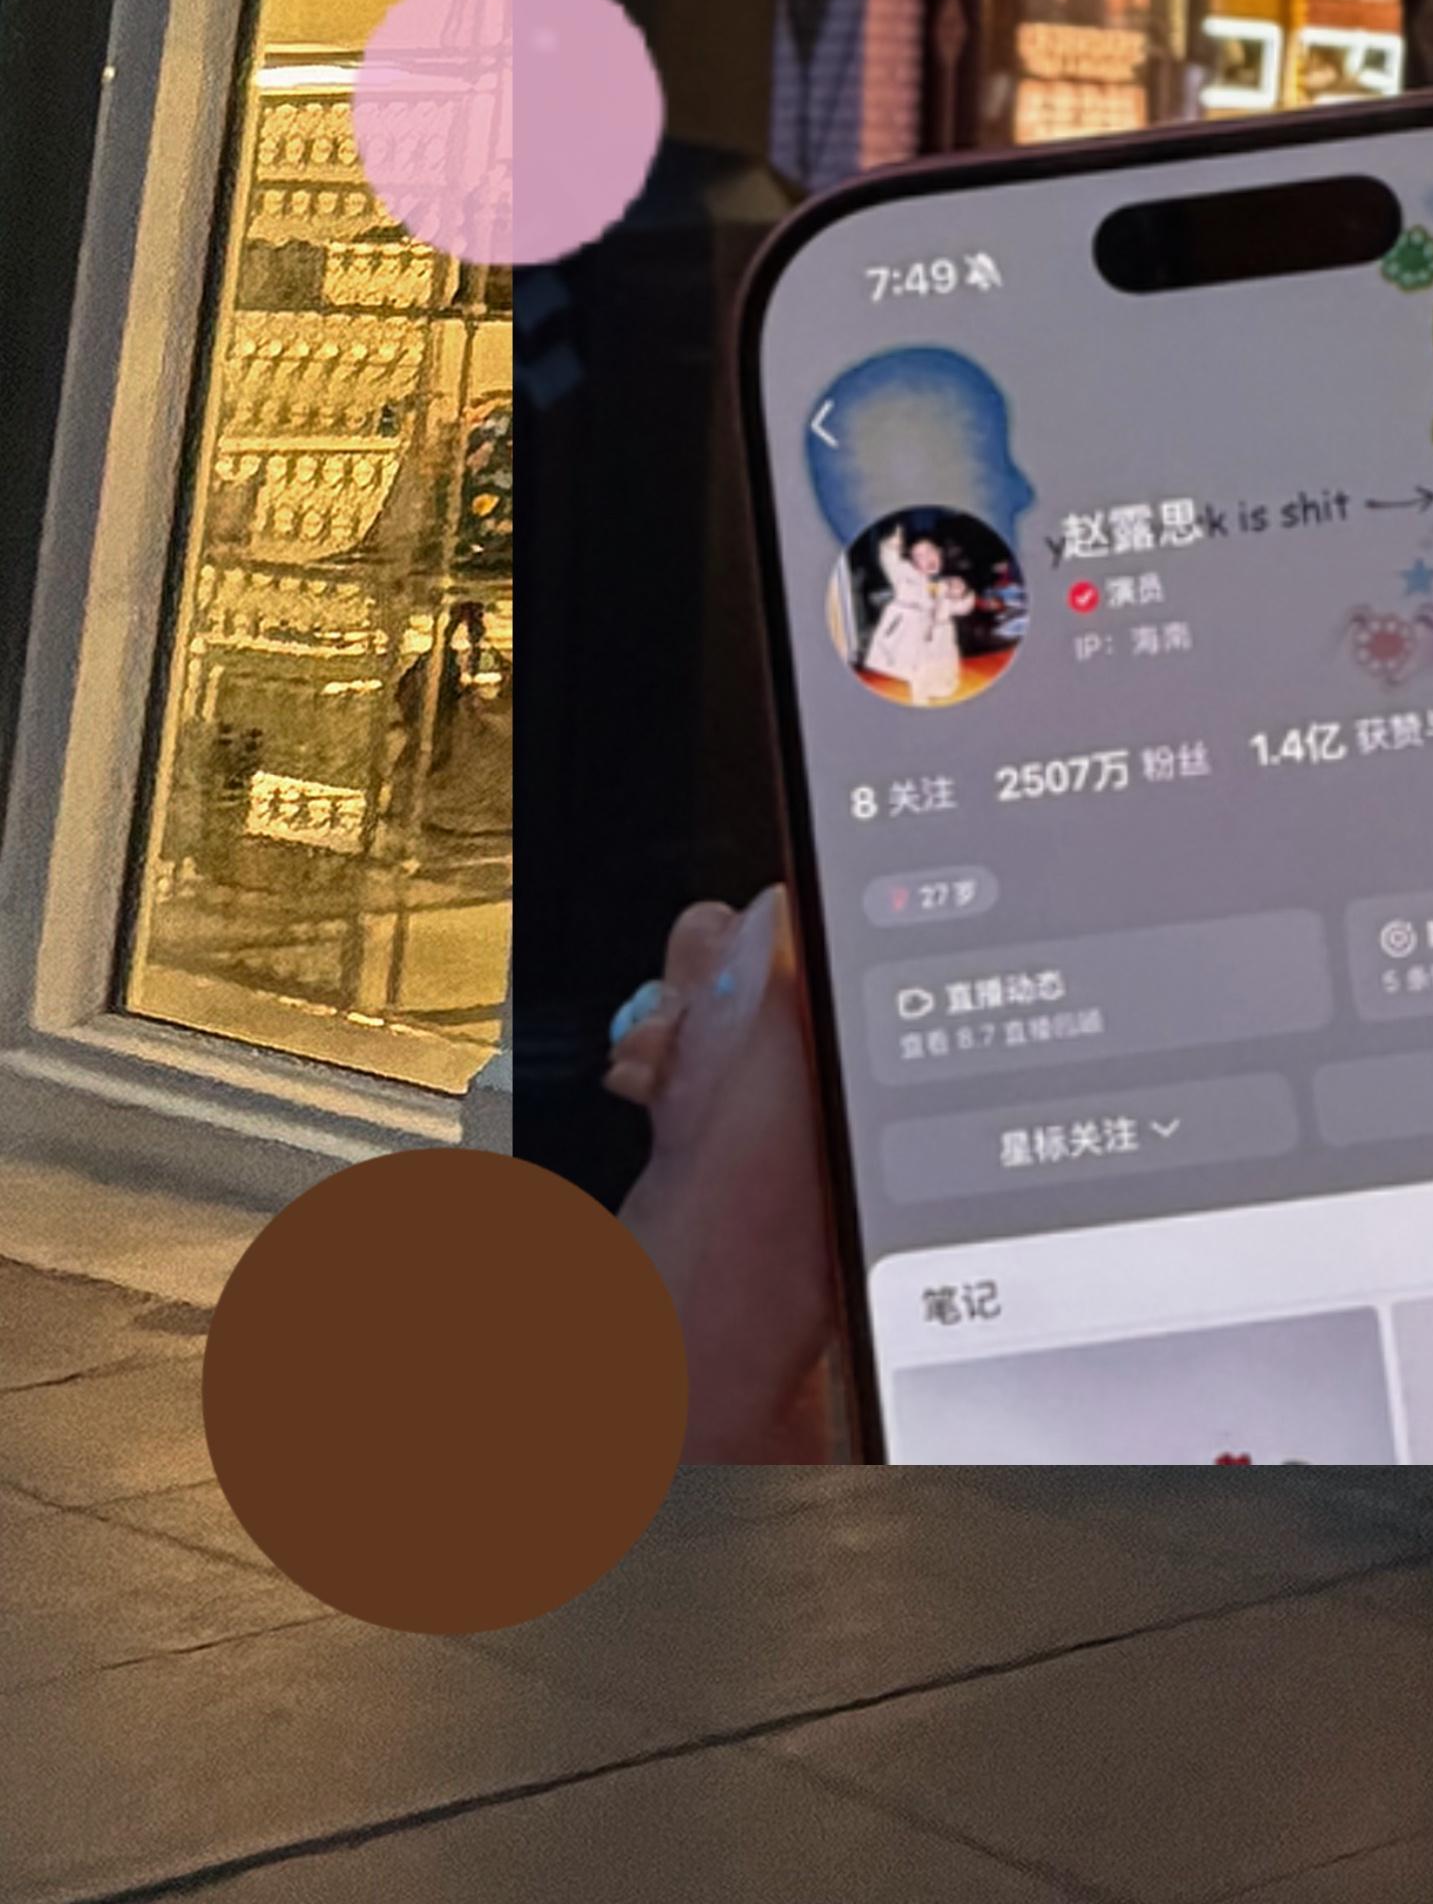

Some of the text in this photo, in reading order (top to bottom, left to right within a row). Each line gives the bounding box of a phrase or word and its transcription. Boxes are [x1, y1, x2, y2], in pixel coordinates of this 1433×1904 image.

[865, 256, 958, 302] 7:49
[1060, 497, 1202, 562] 赵露思
[1238, 496, 1269, 535] is
[1280, 491, 1350, 531] shit
[1106, 575, 1165, 609] 演员
[850, 786, 877, 821] 8
[888, 777, 957, 817] 关注
[995, 750, 1131, 804] 2507万
[1141, 743, 1212, 782] 粉丝
[1249, 722, 1347, 769] 1.4亿
[945, 970, 1067, 1016] 直播动态
[1000, 1117, 1140, 1168] 星标关注
[921, 1279, 1001, 1328] 笔记
